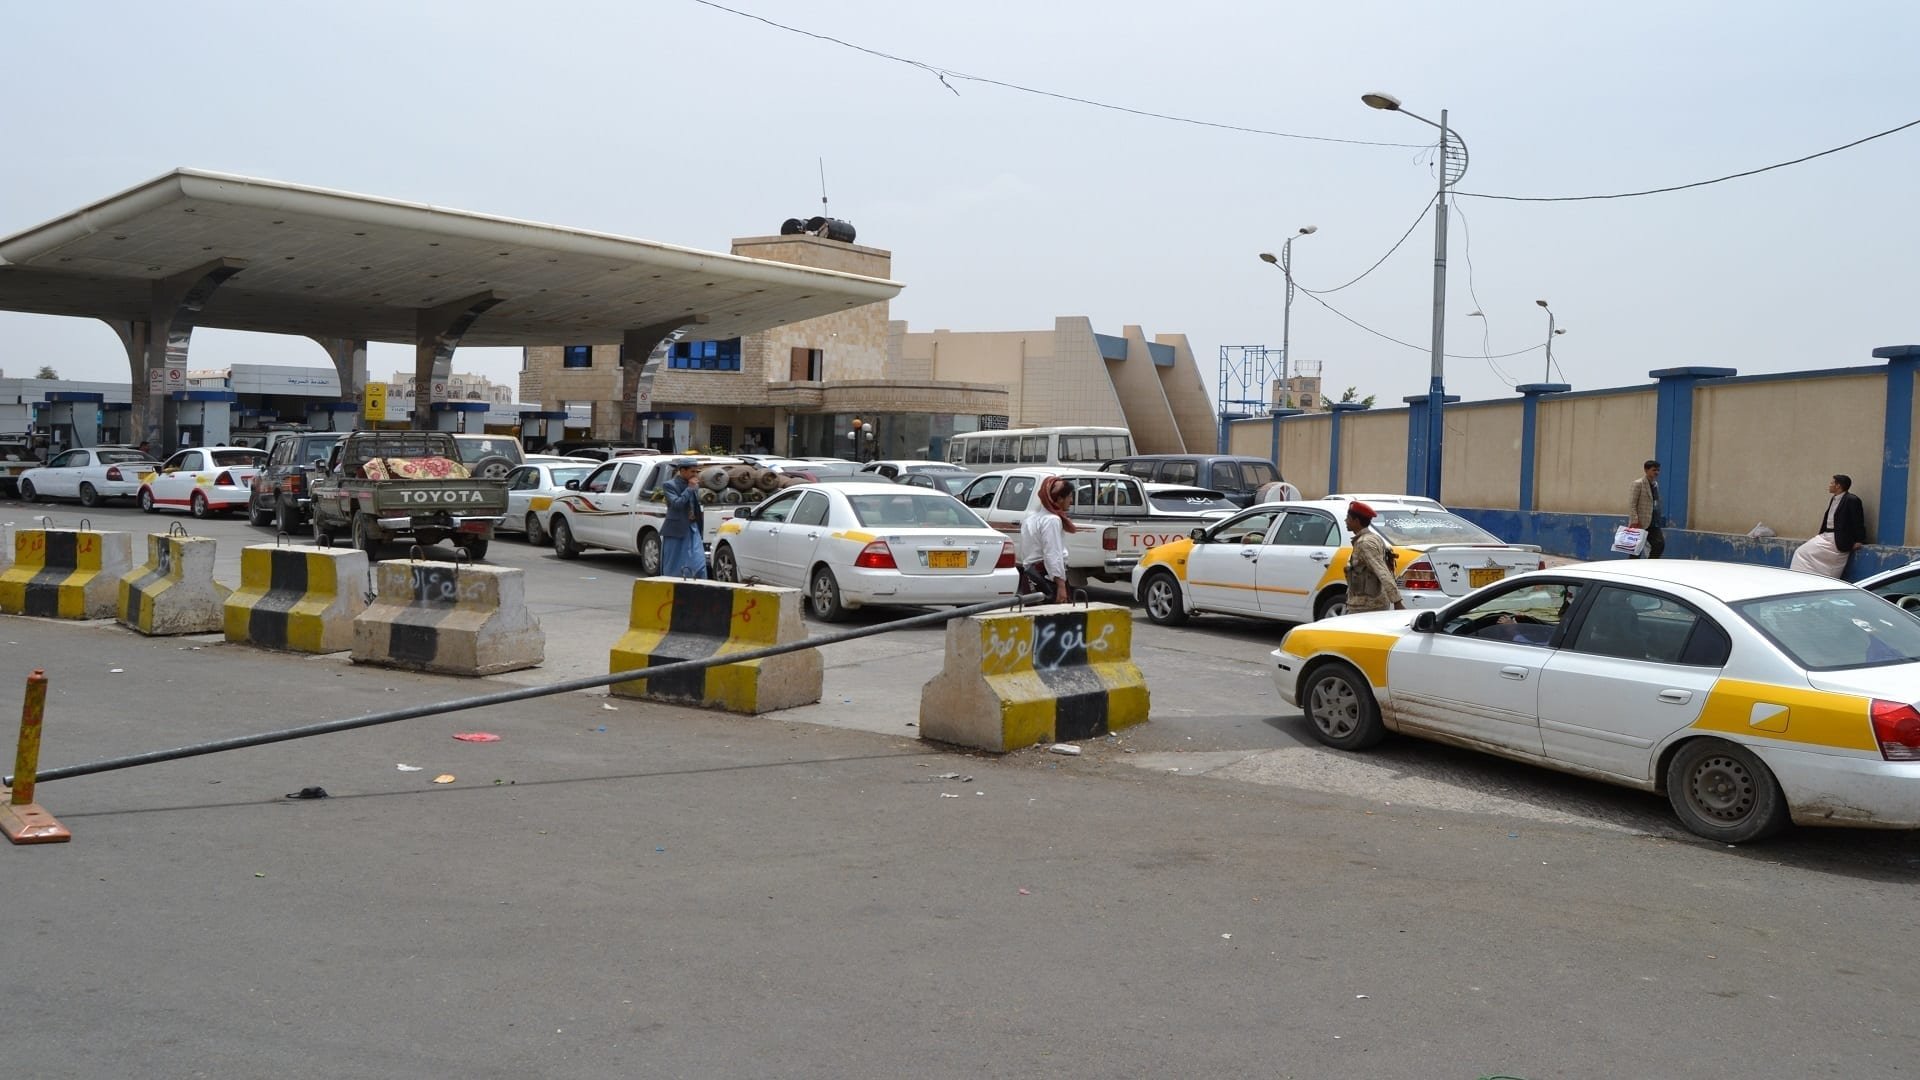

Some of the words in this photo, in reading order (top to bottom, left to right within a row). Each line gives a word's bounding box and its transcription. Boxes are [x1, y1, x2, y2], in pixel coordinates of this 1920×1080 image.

[400, 490, 484, 503] TOYOTA
[1130, 534, 1184, 547] TOYO
[1037, 622, 1116, 671] ممنوع
